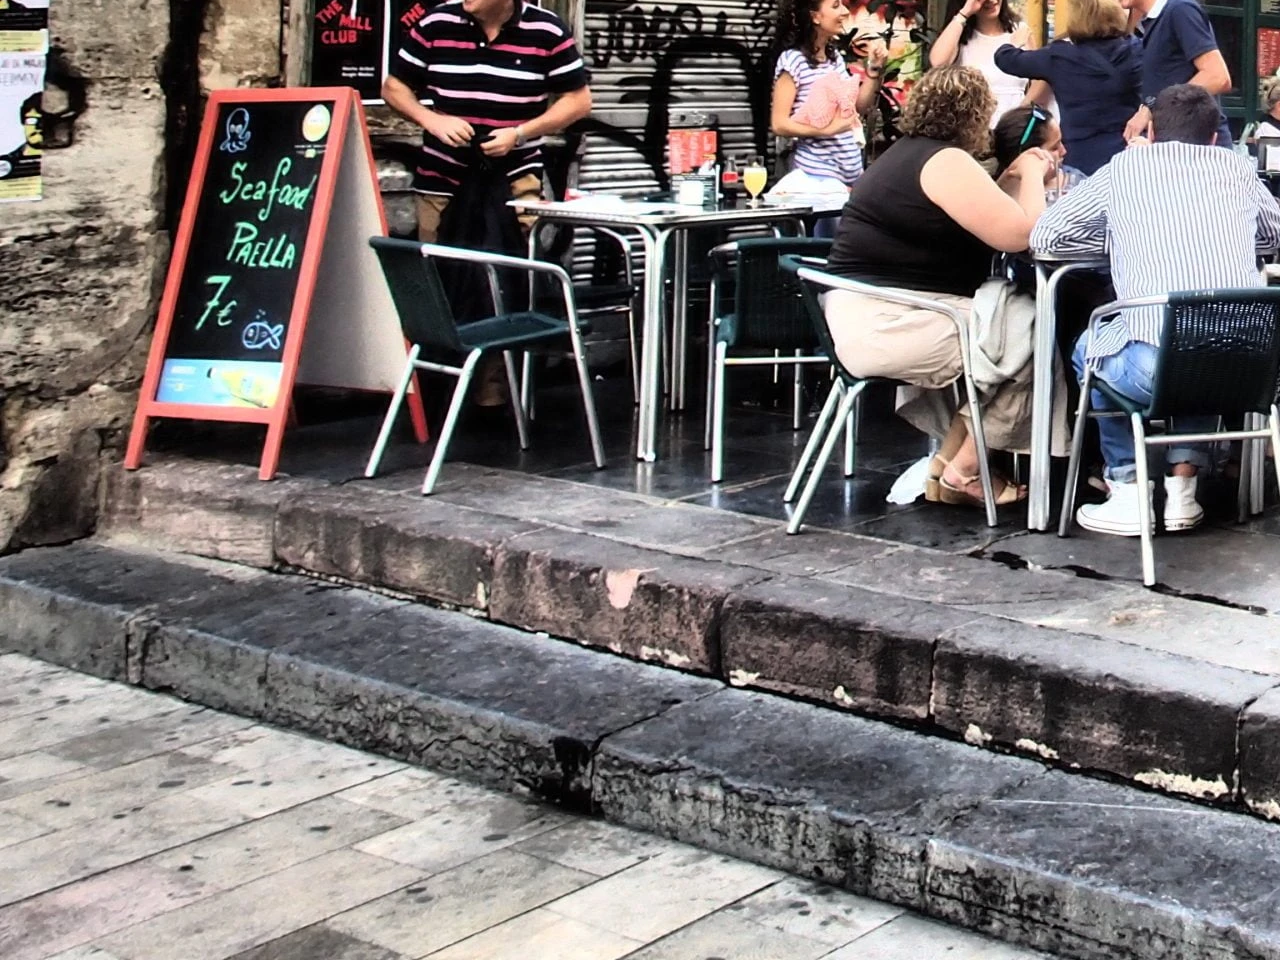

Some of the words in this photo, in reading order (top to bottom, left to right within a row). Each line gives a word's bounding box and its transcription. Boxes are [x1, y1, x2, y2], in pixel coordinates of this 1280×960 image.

[315, 0, 343, 23] THE
[400, 3, 426, 27] THE
[321, 30, 357, 44] CLUB
[219, 157, 317, 221] Seafood
[226, 221, 296, 270] PAELLA
